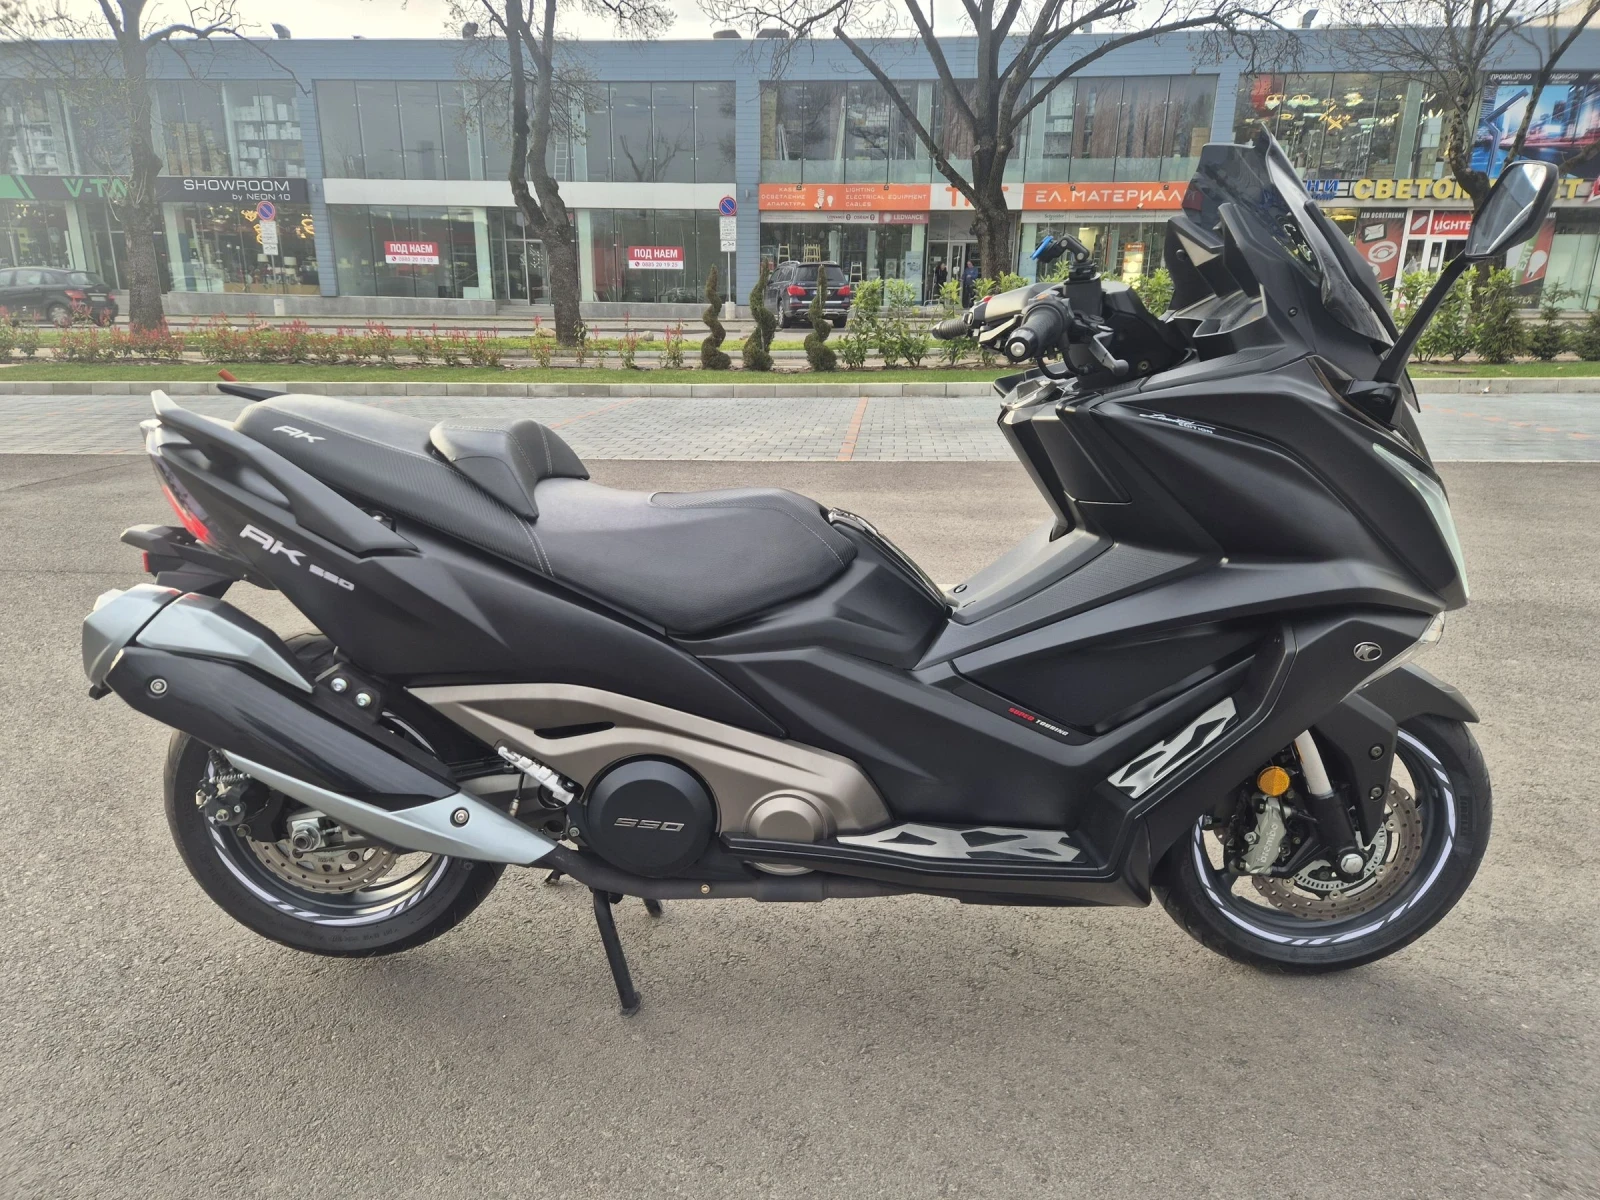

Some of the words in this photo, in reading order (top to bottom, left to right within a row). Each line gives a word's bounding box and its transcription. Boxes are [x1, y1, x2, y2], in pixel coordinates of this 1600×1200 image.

[62, 178, 129, 198] V-TA
[183, 179, 290, 191] SHOWROOM
[1434, 220, 1472, 230] LIGHTE
[390, 243, 408, 254] ПОД
[409, 244, 433, 253] НАЕМ
[634, 248, 652, 259] ПОД
[653, 249, 678, 258] НАЕМ
[272, 425, 327, 443] AK
[239, 524, 307, 566] AK
[1035, 719, 1069, 736] TOURING
[1256, 823, 1278, 863] brembo
